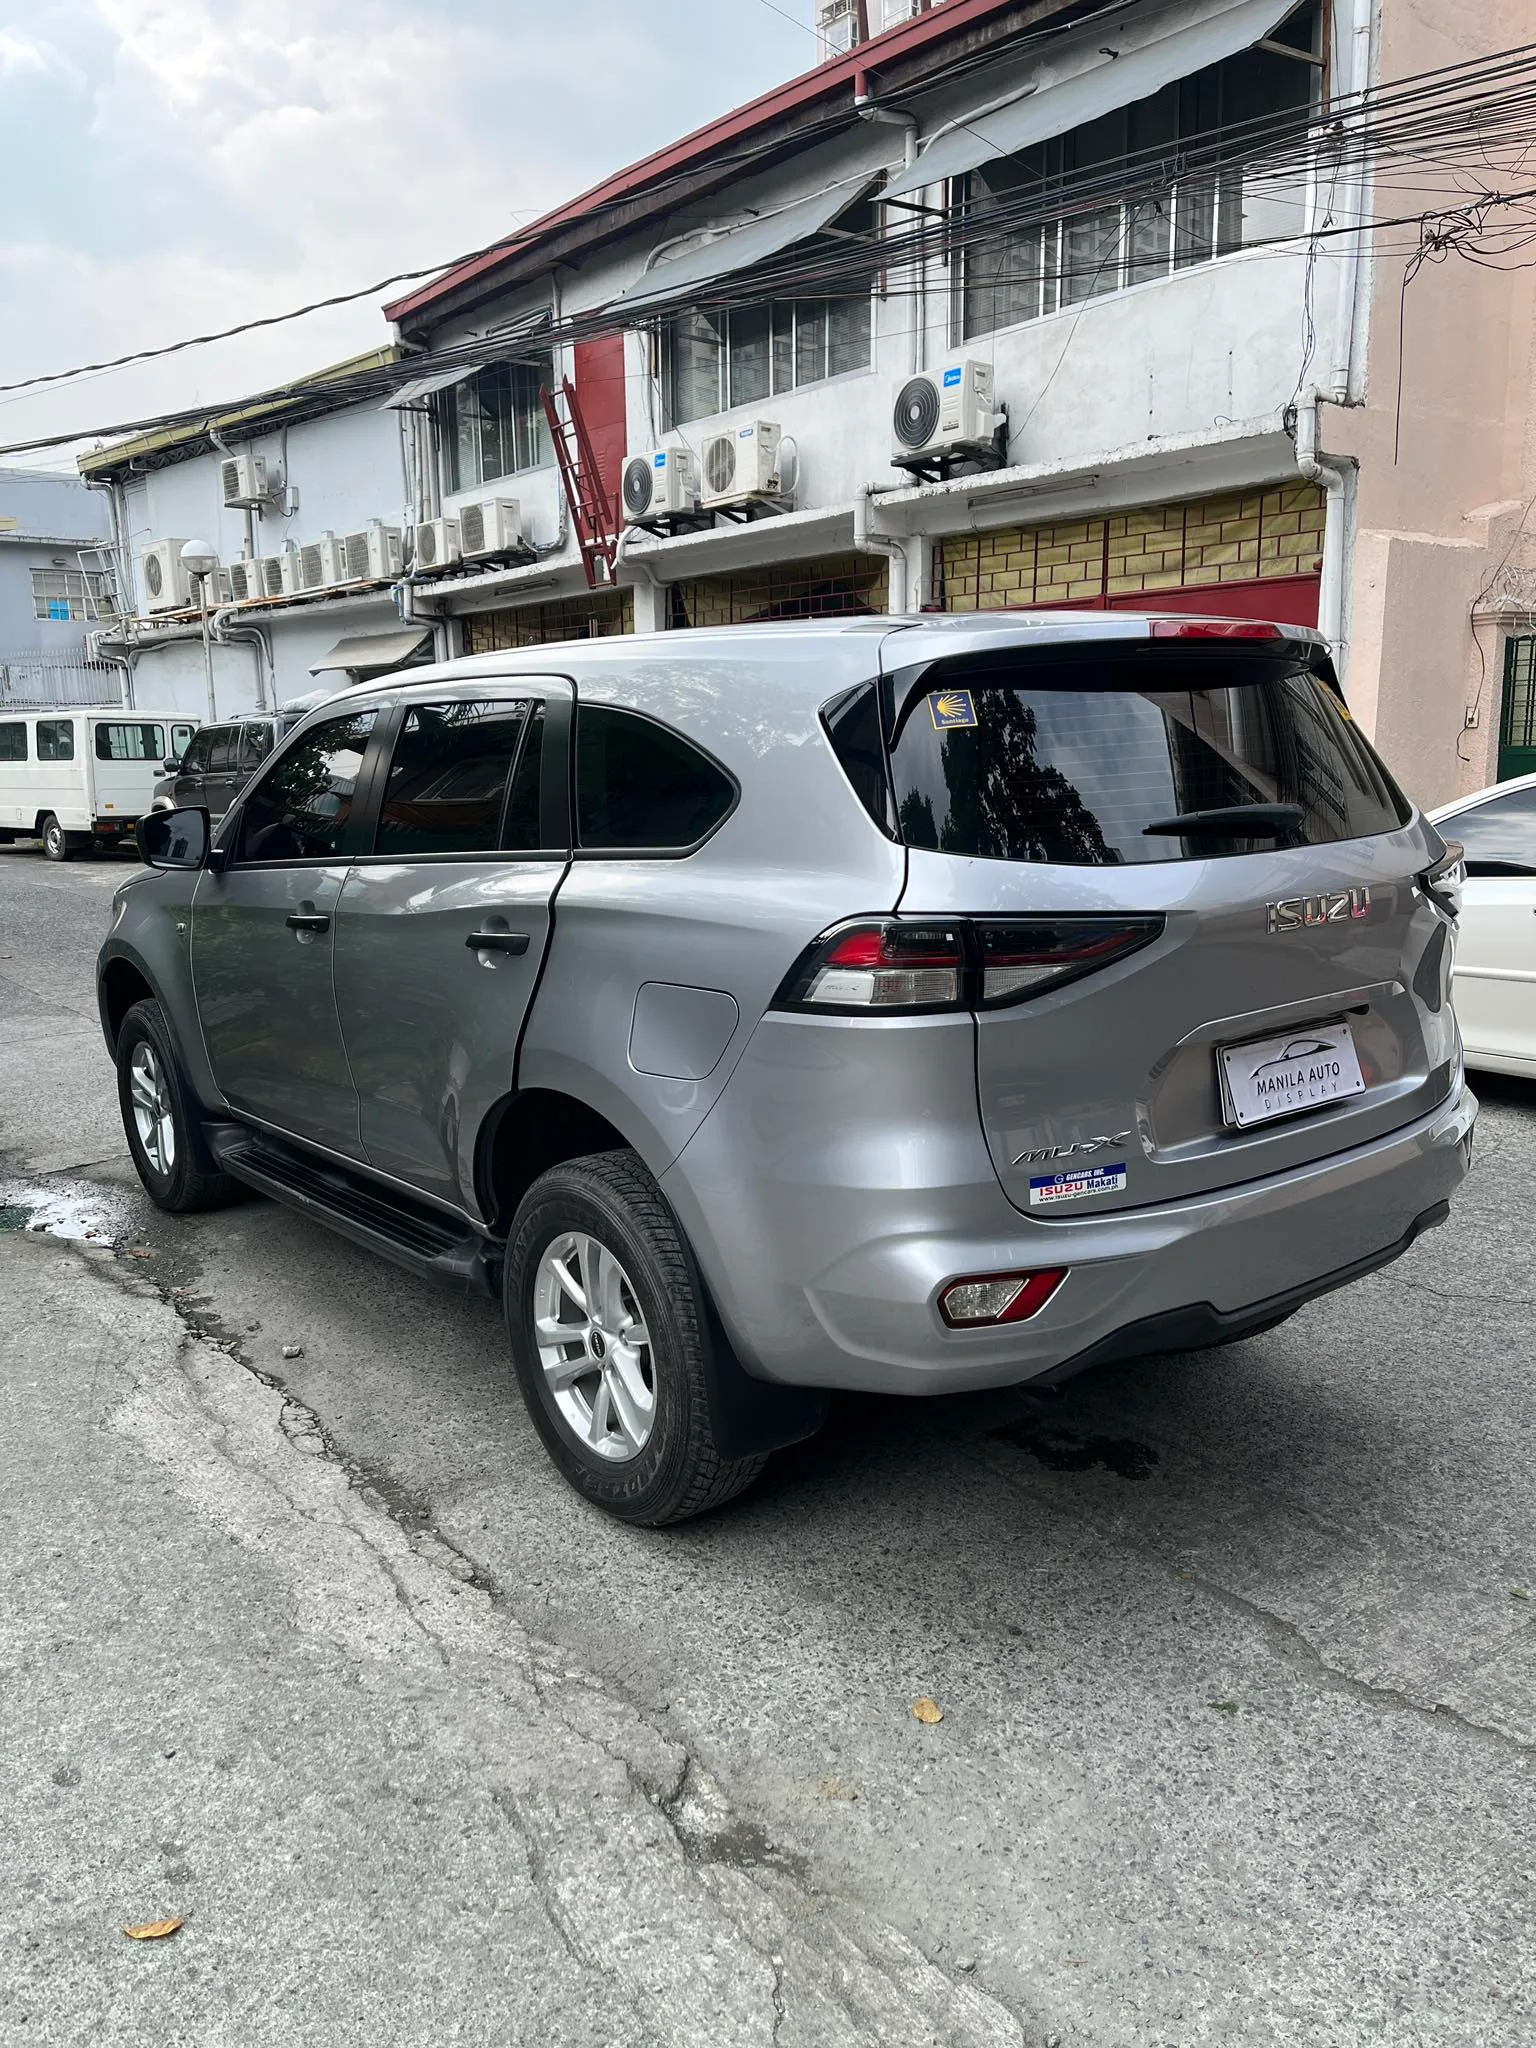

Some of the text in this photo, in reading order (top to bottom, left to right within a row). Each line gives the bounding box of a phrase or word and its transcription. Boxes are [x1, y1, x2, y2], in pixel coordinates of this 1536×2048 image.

[1265, 886, 1372, 935] ISUZU
[1257, 1061, 1341, 1096] MANILA AUTO
[1264, 1081, 1339, 1111] DISPLAY
[1038, 1185, 1119, 1202] www.isuzu-gencars.com.ph
[1040, 1175, 1118, 1196] ISUZU Makati
